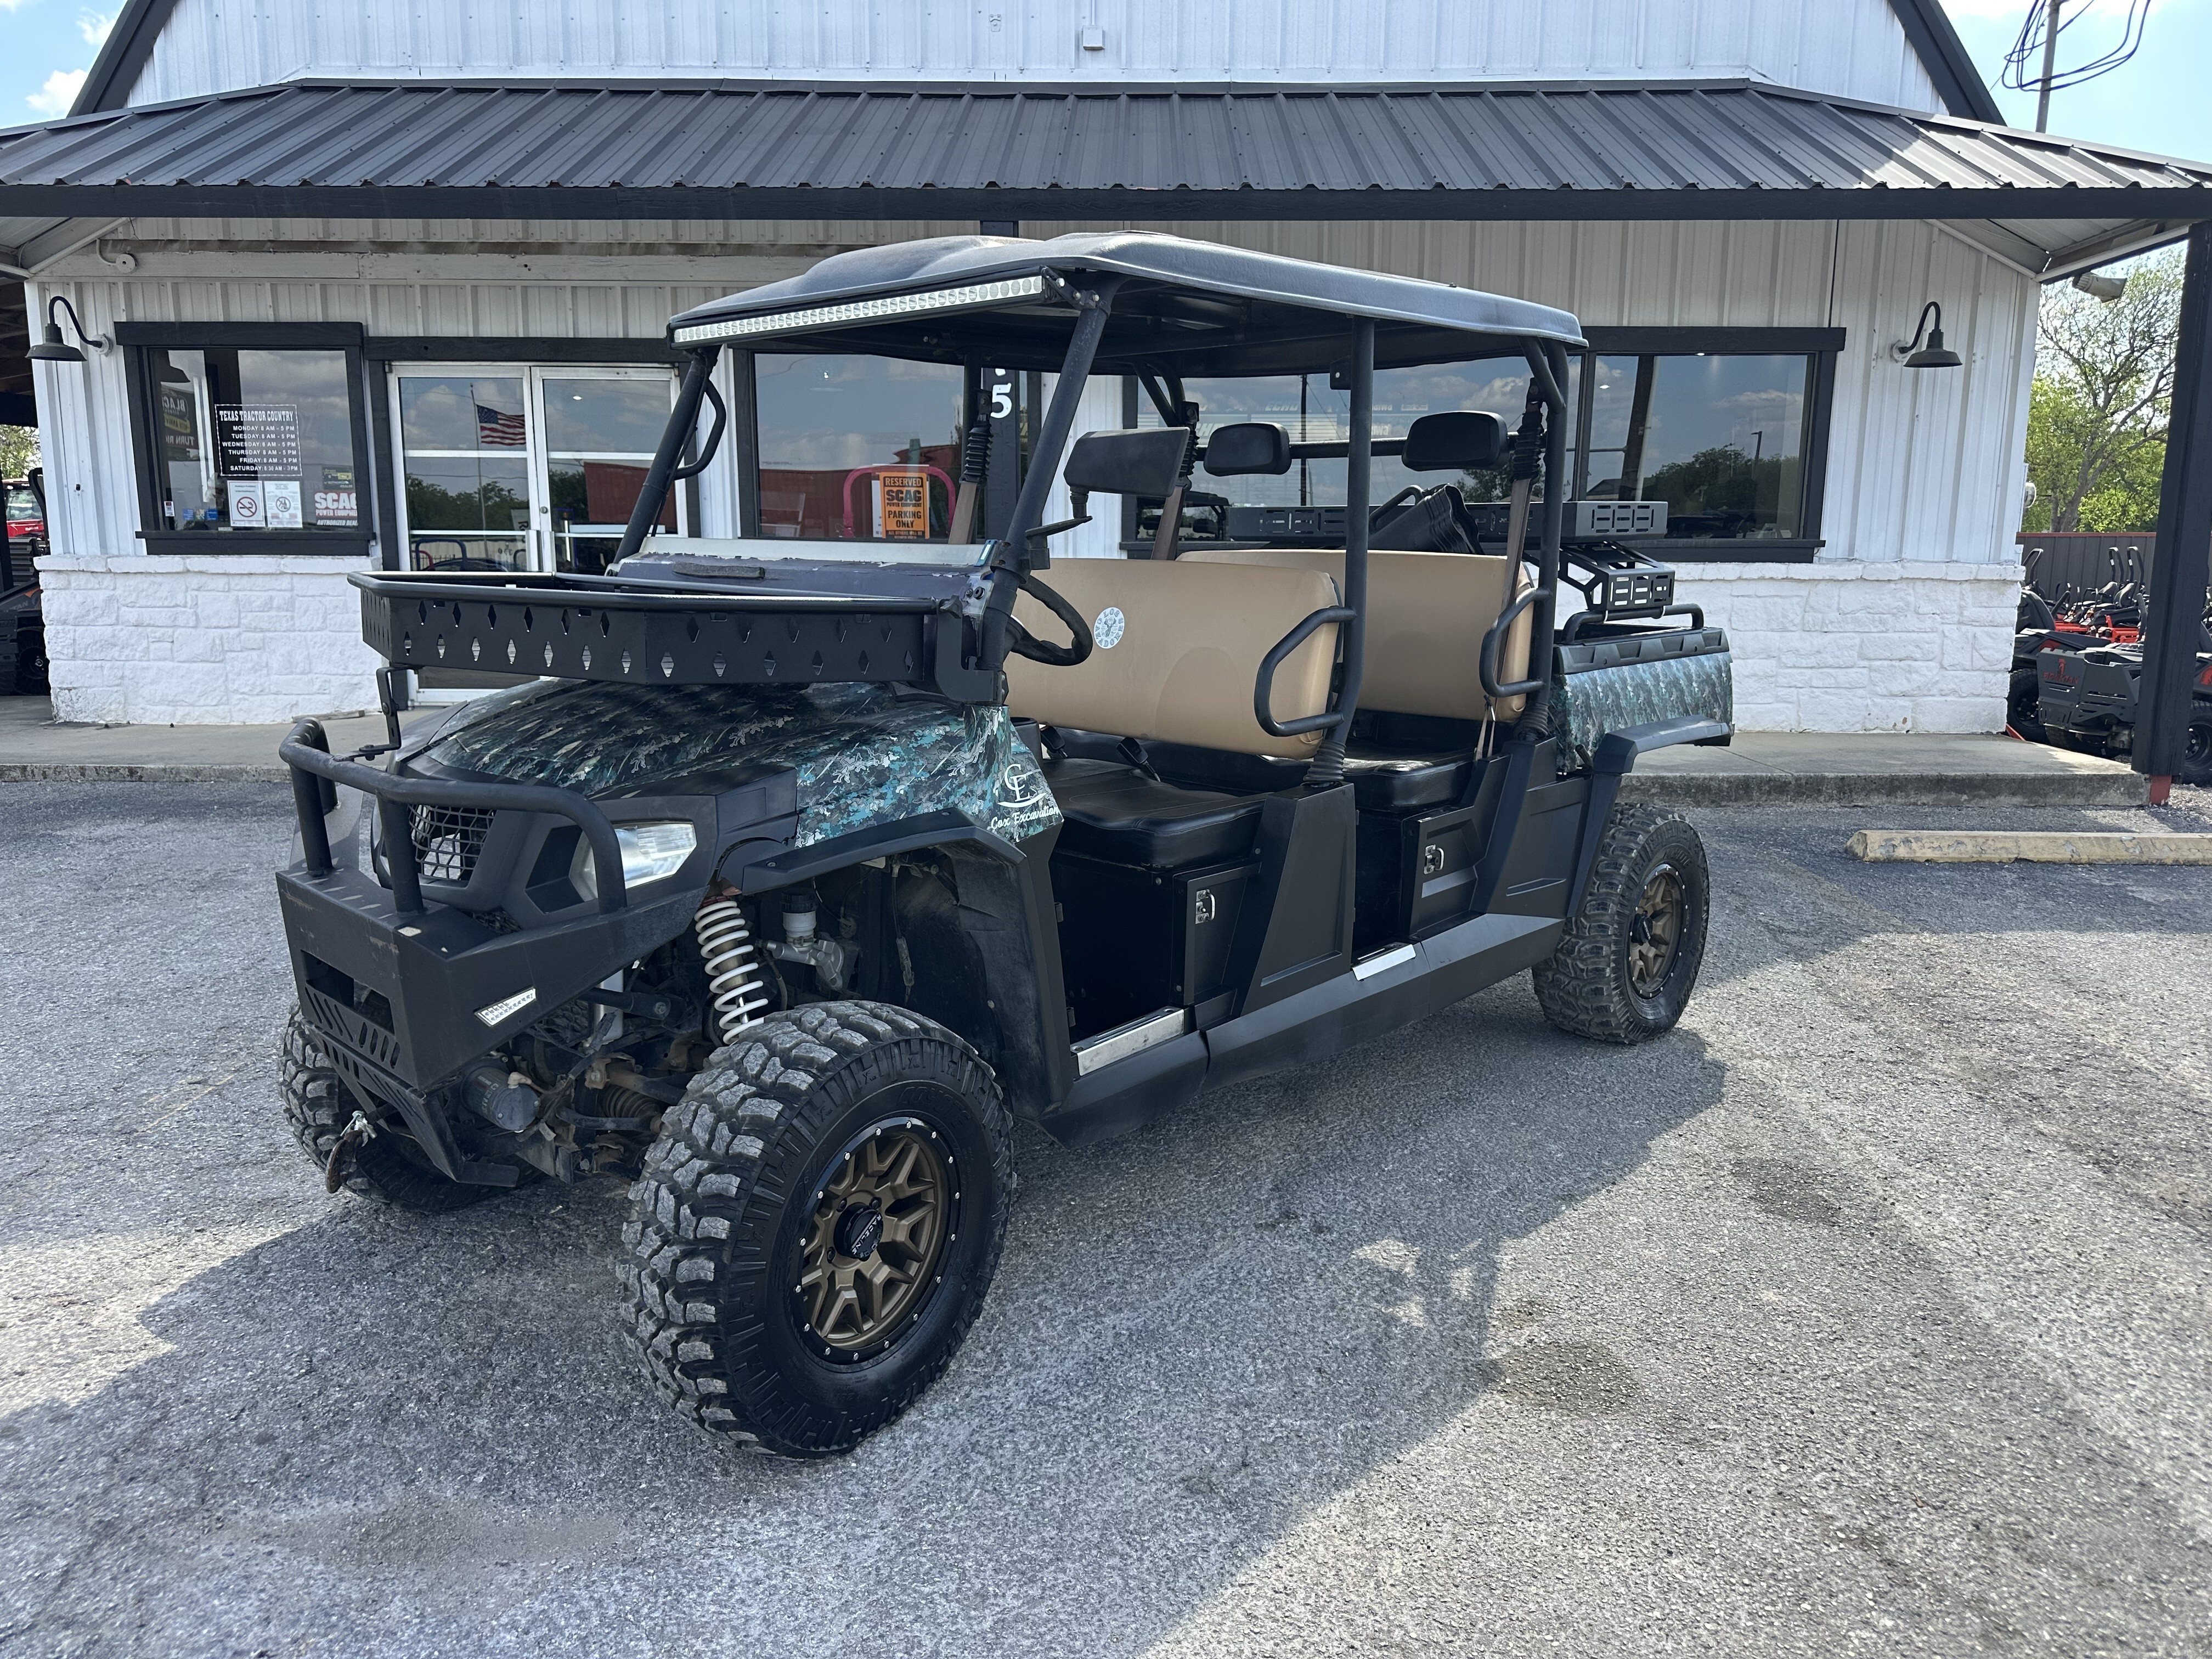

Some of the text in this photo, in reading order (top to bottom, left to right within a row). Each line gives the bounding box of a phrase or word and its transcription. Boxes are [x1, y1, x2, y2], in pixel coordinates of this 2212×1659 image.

[990, 383, 1012, 419] 5
[219, 410, 294, 421] TEXAS TRACTOR COUNTRY
[885, 477, 922, 486] RESERVED
[886, 489, 922, 502] SCAG
[888, 510, 922, 519] PARKING
[896, 520, 915, 528] ONLY
[991, 806, 1059, 830] Cox Excavation
[852, 1214, 882, 1255] RACELINE
